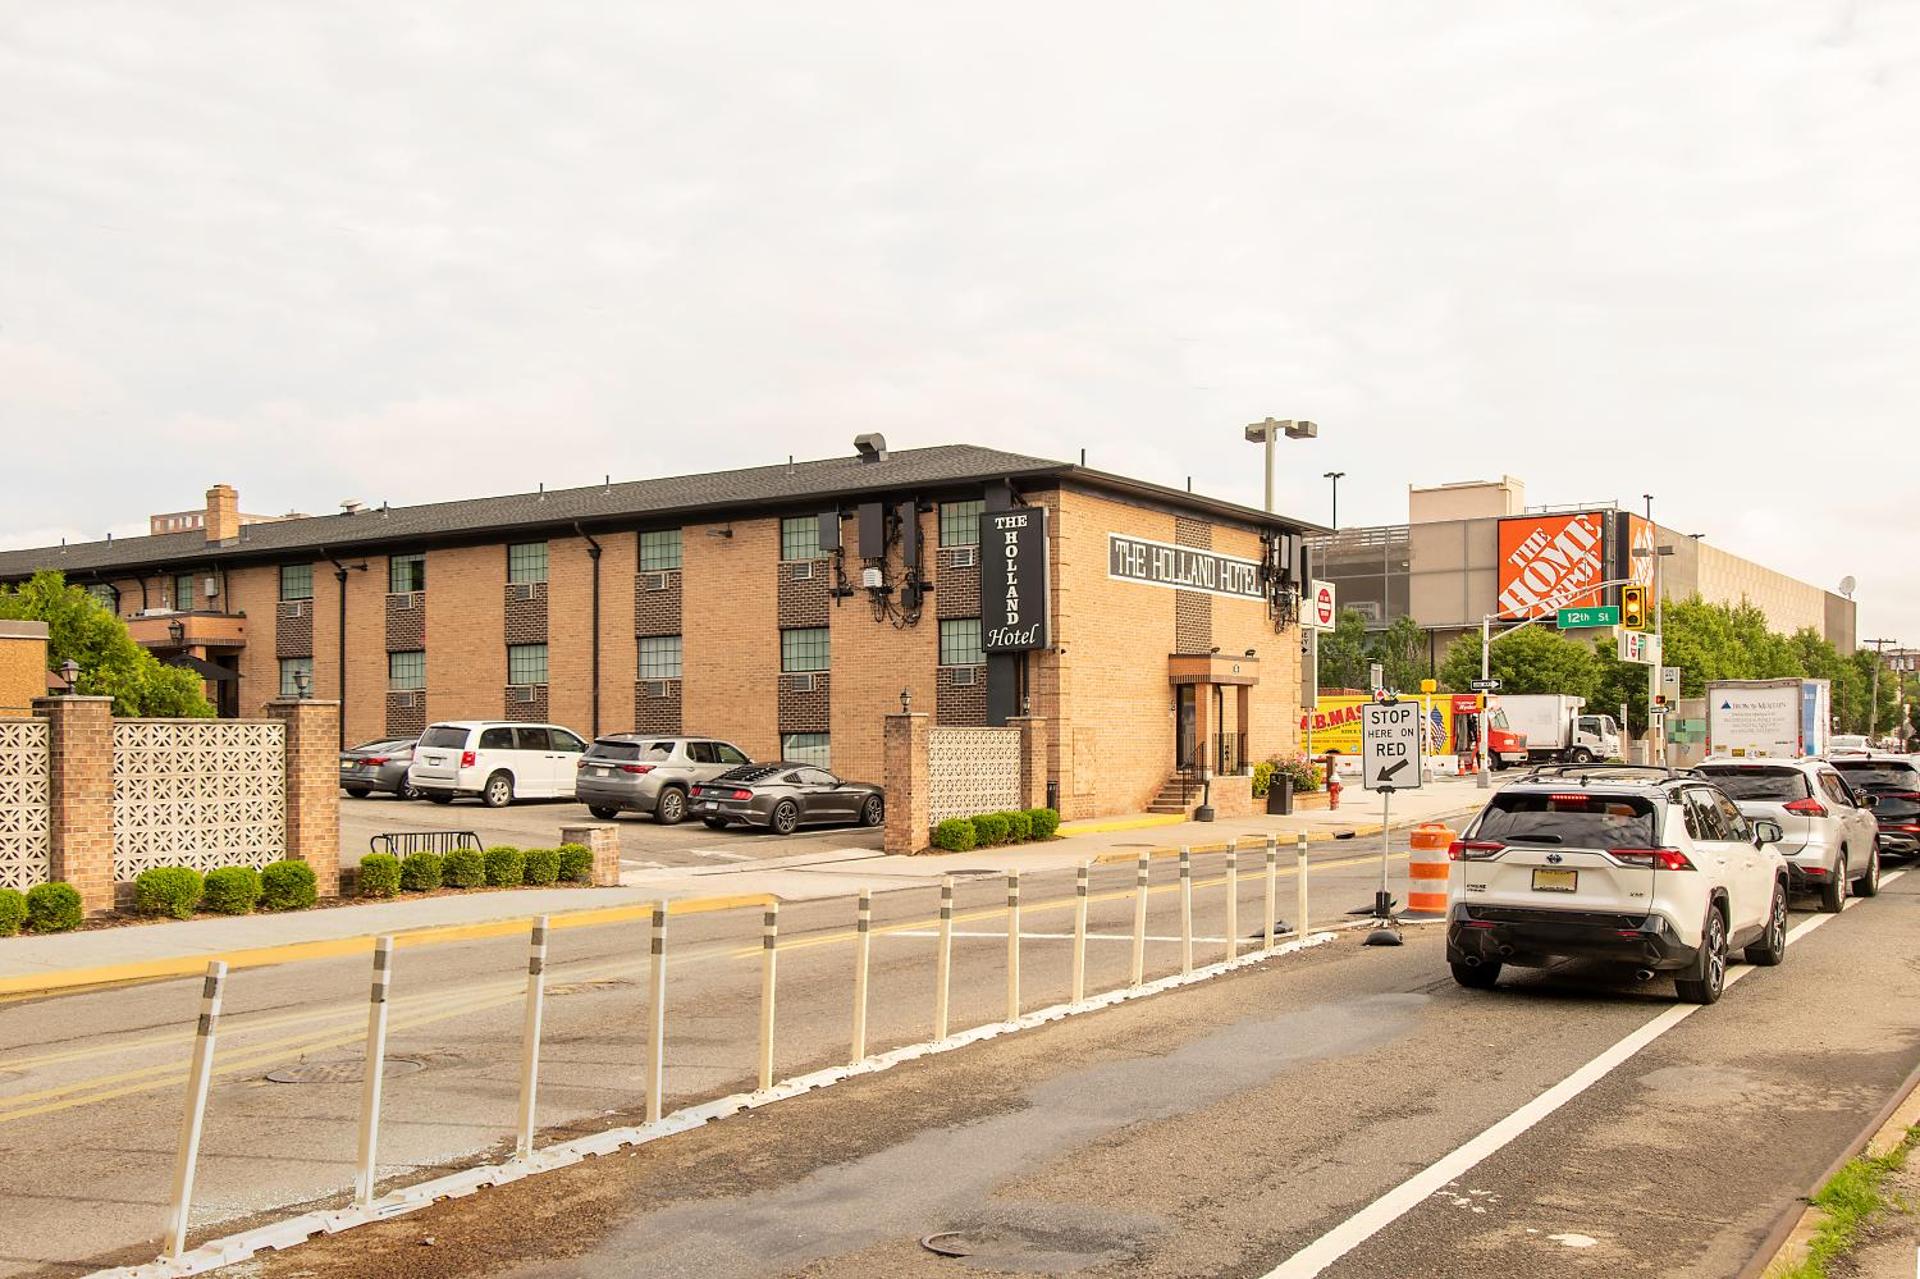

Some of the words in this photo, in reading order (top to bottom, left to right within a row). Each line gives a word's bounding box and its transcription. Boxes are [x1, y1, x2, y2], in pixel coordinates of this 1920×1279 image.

[995, 515, 1028, 530] THE
[1507, 527, 1552, 569] THE
[1115, 540, 1147, 577] THE
[1152, 547, 1216, 588] HOLLAND
[1220, 560, 1262, 596] HOTEL
[1498, 514, 1602, 618] HOME
[1004, 531, 1020, 625] HOLLAND
[1567, 612, 1590, 623] 12th
[1598, 612, 1609, 622] St
[987, 623, 1040, 648] Hotel
[1371, 709, 1410, 725] STOP
[1368, 728, 1392, 738] HERE
[1401, 728, 1414, 737] ON
[1376, 742, 1406, 757] RED
